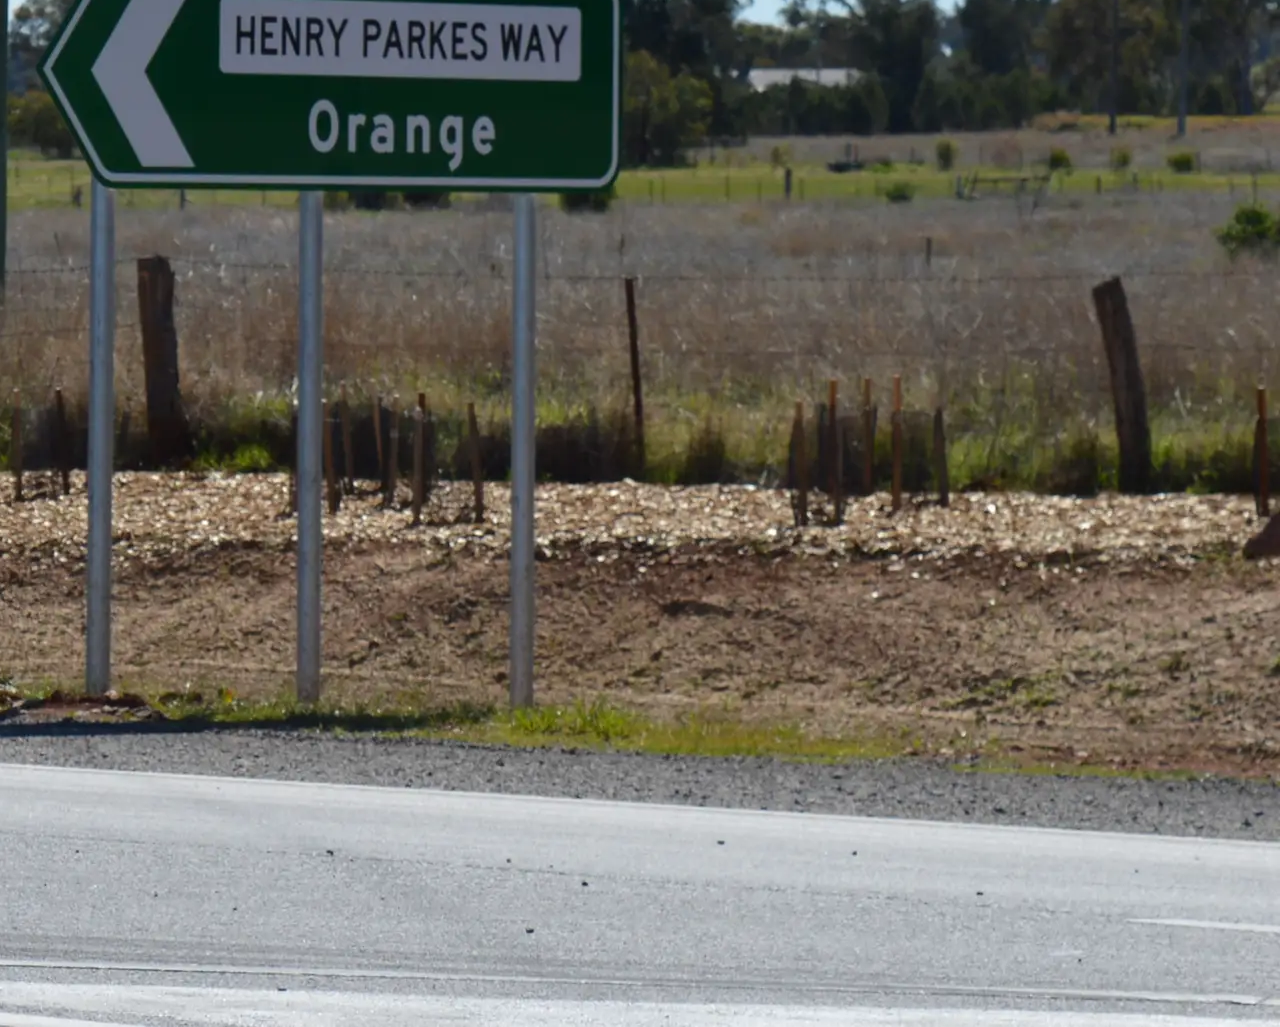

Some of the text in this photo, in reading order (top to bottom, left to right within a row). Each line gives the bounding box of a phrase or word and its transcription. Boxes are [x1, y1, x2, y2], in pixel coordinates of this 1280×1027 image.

[235, 15, 568, 63] HENRY PARKES WAY
[308, 99, 496, 172] Orange
